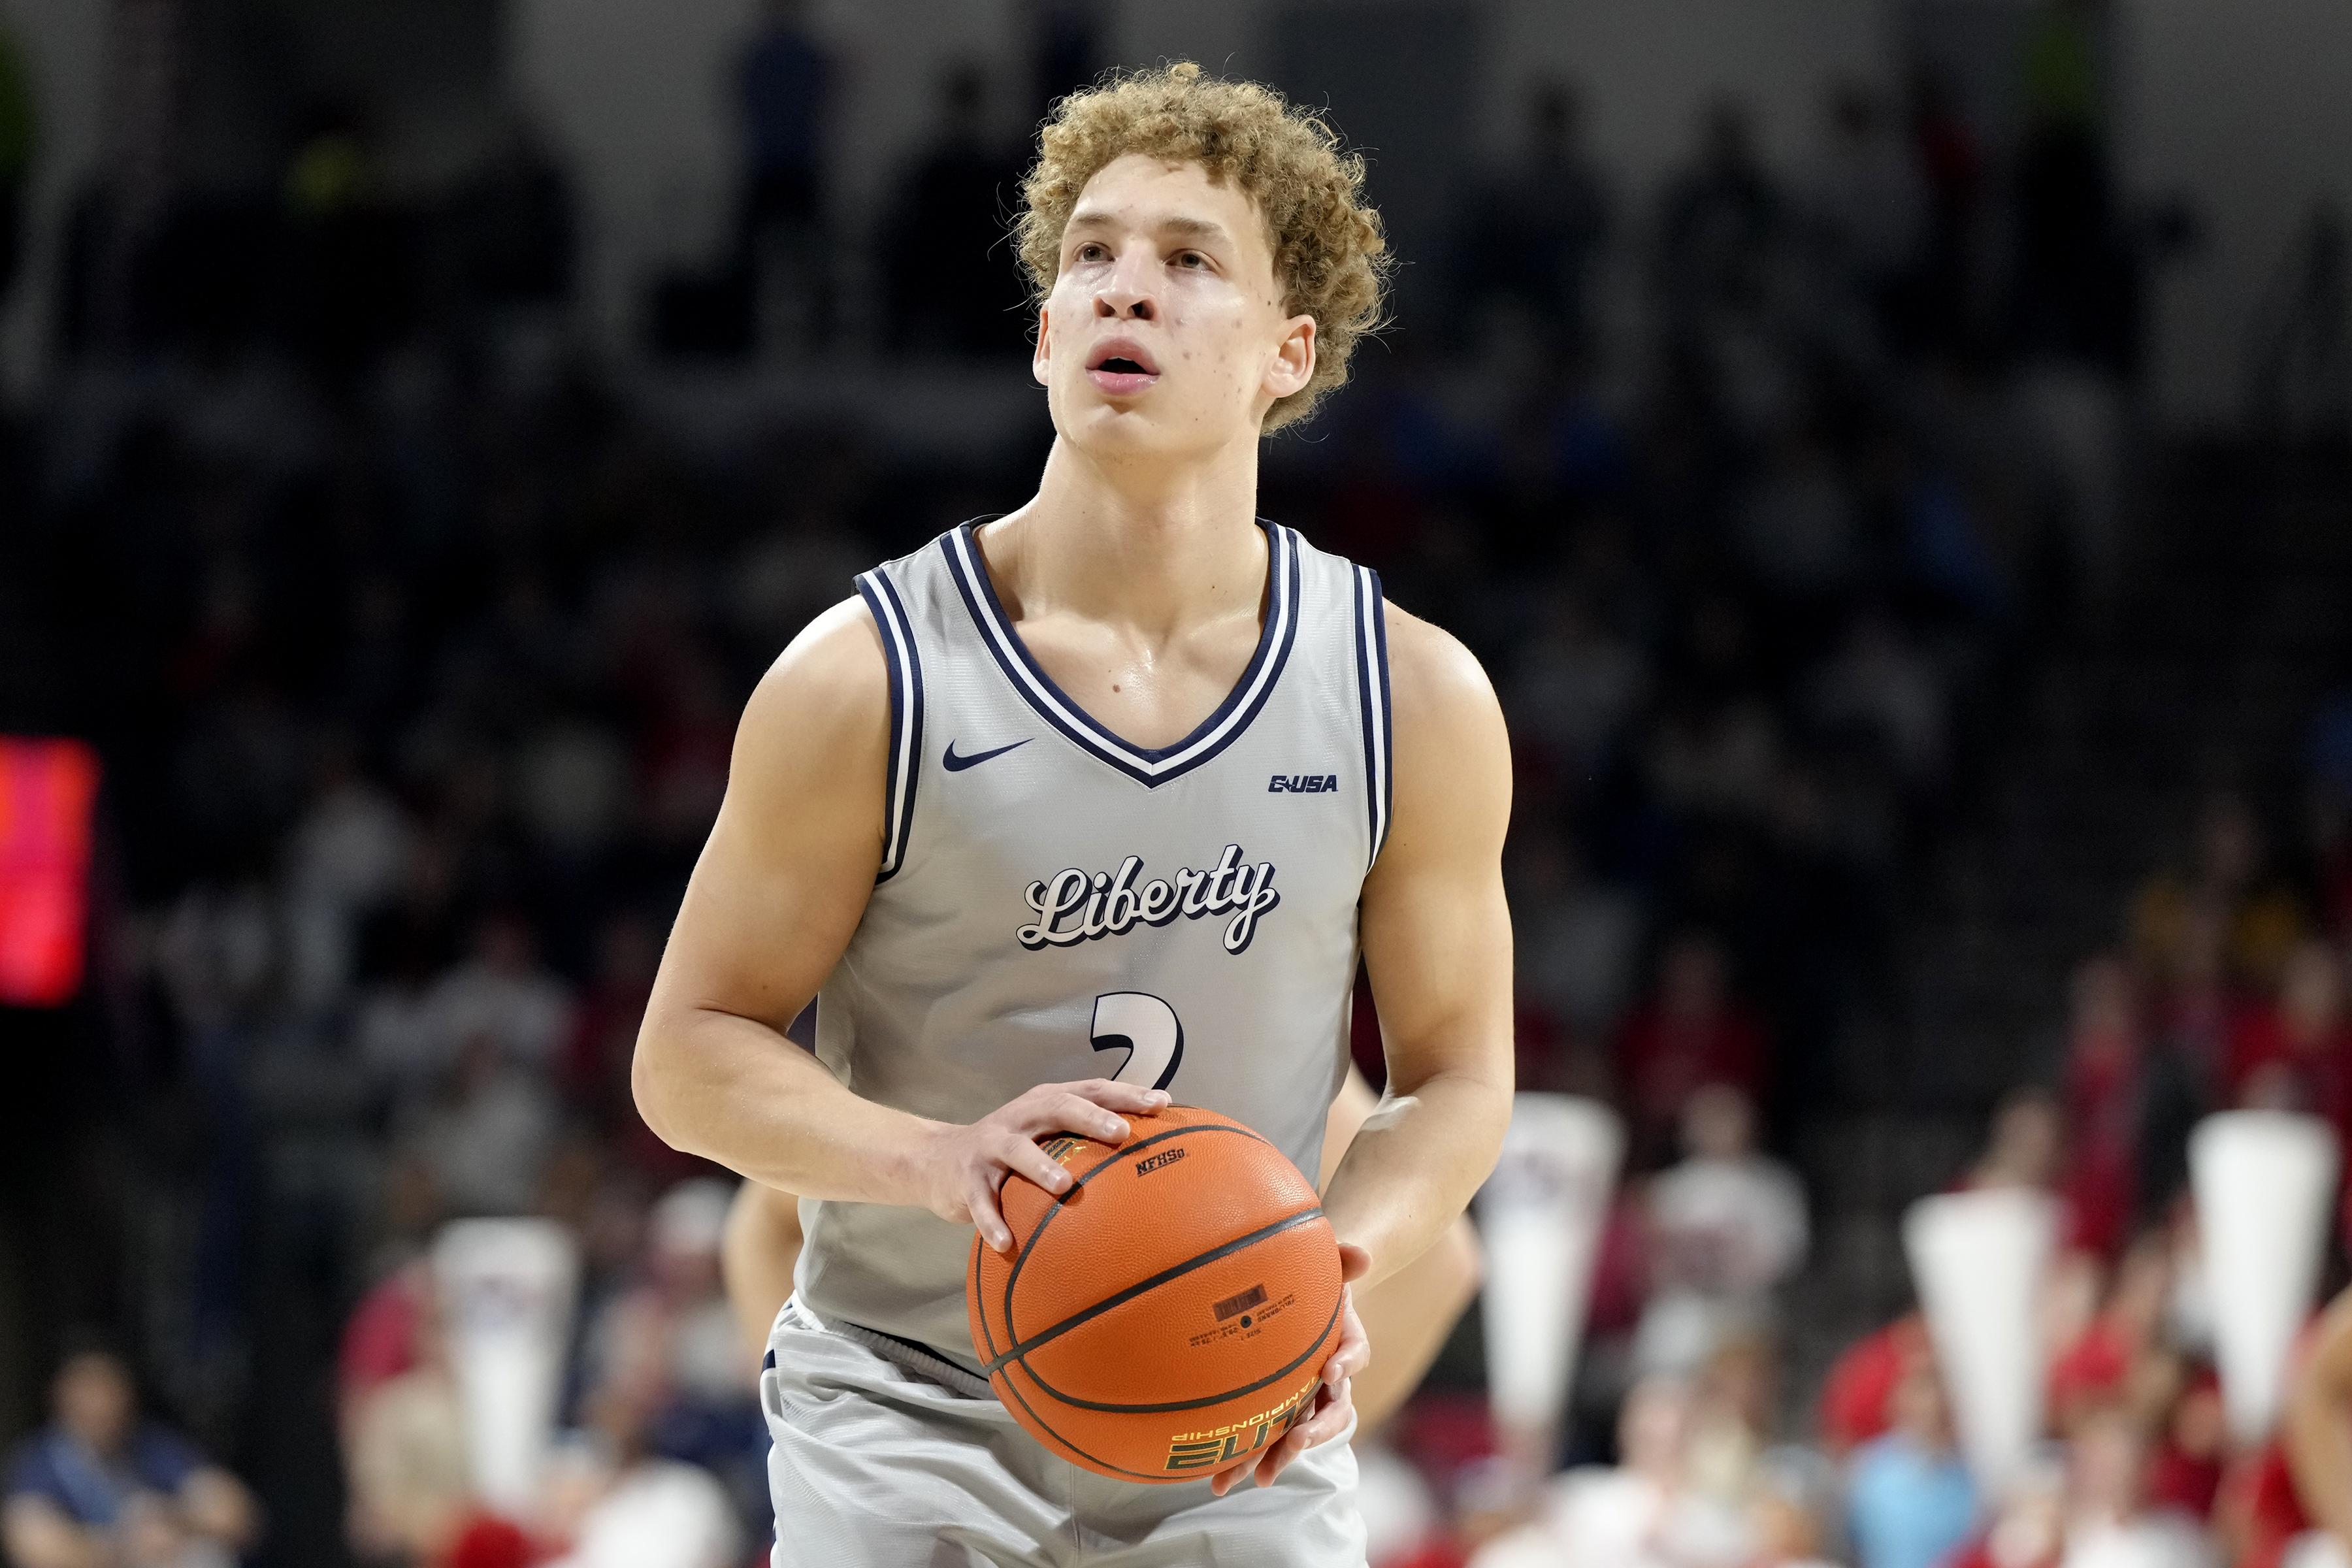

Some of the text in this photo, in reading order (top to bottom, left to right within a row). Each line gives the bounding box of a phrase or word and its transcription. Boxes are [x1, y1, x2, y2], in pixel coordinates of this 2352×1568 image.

[1016, 844, 1281, 955] Liberty
[1090, 991, 1184, 1090] 2
[1171, 1377, 1315, 1441] AMPIONSHIP
